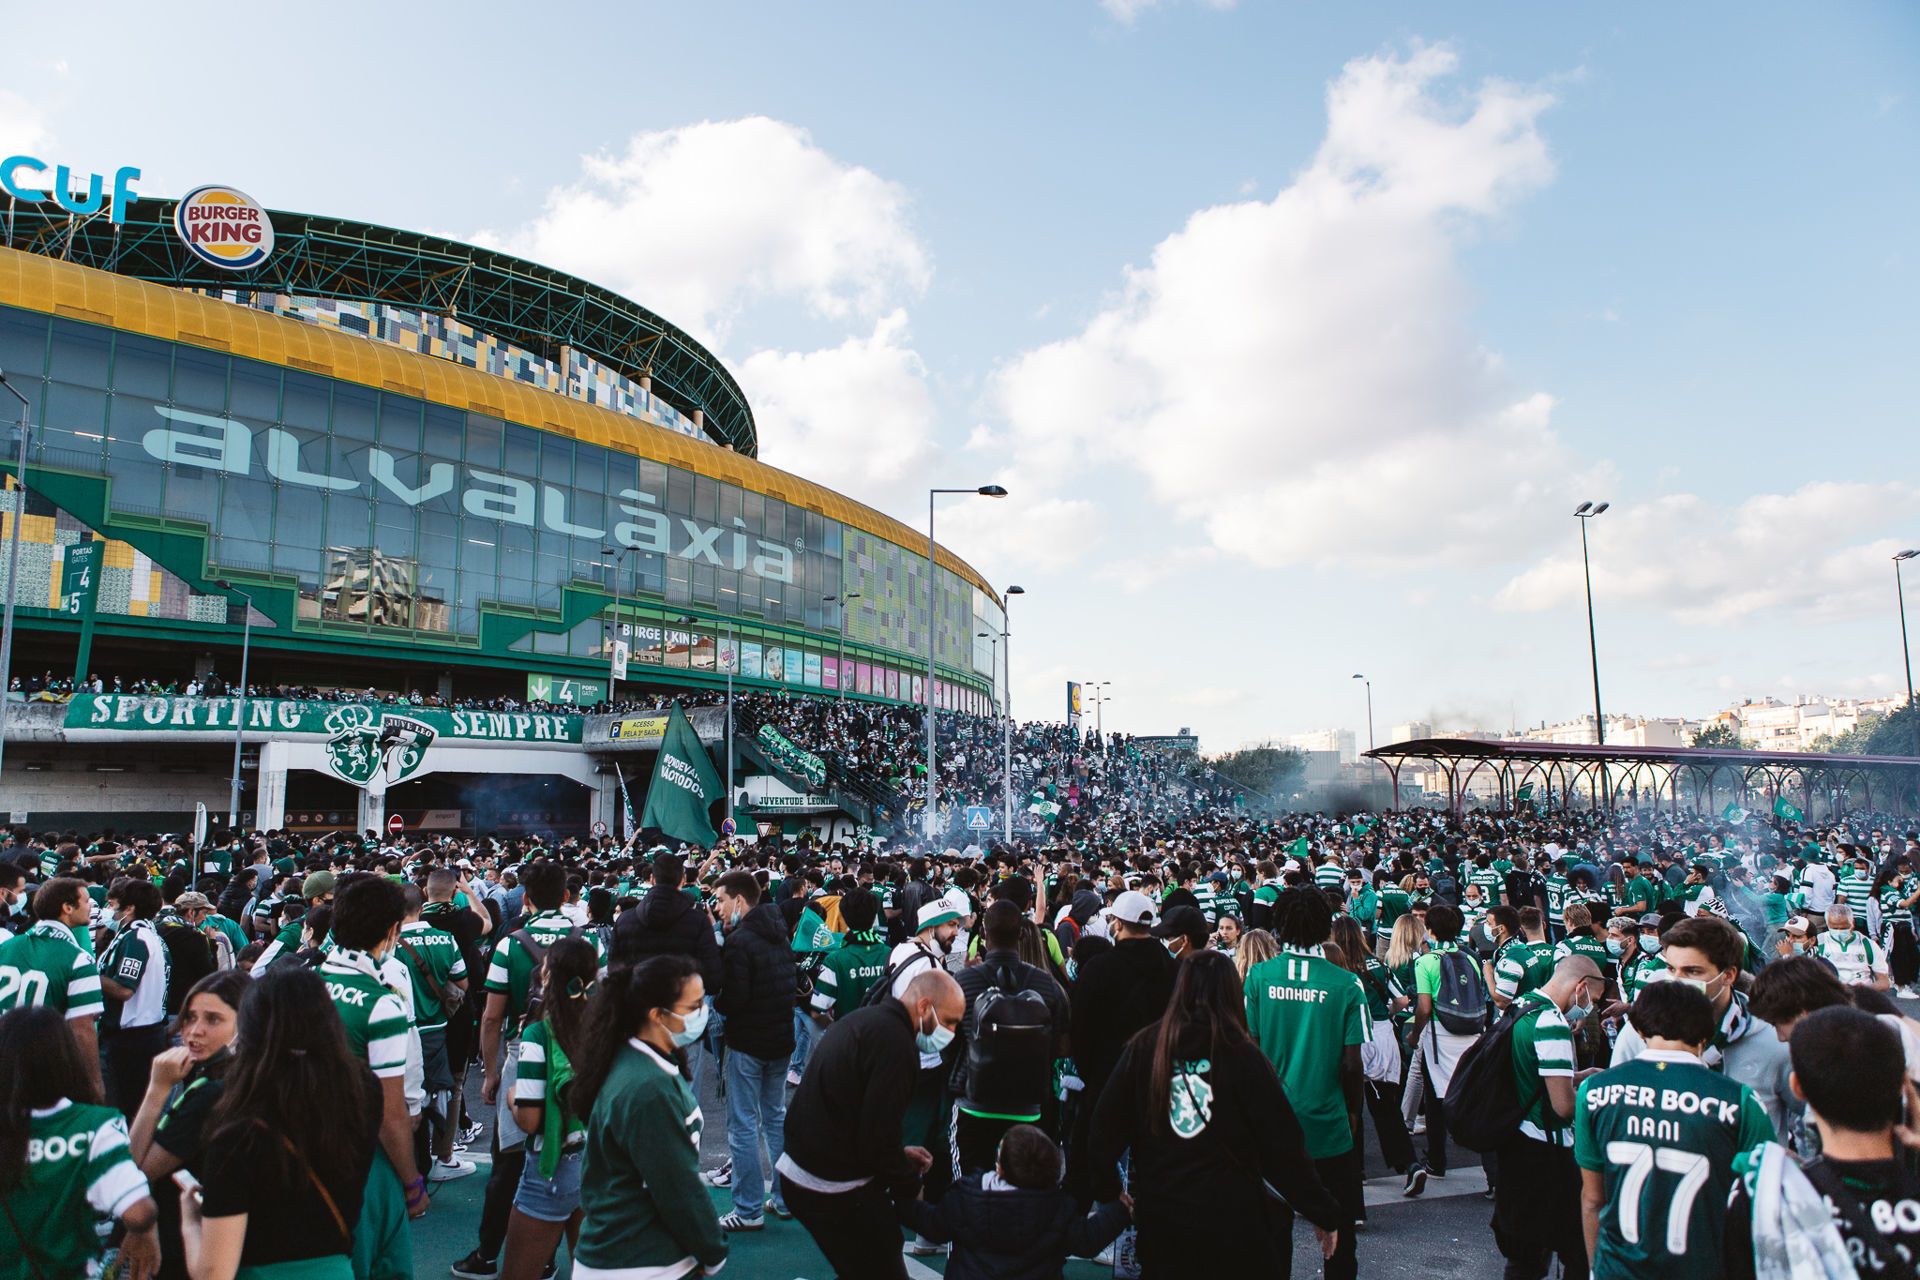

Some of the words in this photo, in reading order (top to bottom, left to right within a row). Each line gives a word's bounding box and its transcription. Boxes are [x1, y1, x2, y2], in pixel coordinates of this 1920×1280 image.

[0, 155, 141, 224] cuf
[188, 206, 259, 222] BURGER
[191, 222, 262, 243] KING
[72, 547, 93, 556] PORTAS
[80, 566, 90, 588] 4
[70, 592, 80, 614] 5
[671, 631, 698, 646] KING
[559, 680, 574, 703] 4
[92, 695, 301, 729] SPORTING
[385, 718, 413, 731] JUVE
[415, 726, 433, 738] LEO
[451, 710, 569, 740] SEMPRE
[612, 726, 620, 737] P
[759, 796, 804, 806] JUVENTUDE
[425, 935, 450, 946] BOCK
[1269, 986, 1328, 1003] BONHOFF
[1586, 1084, 1656, 1111] SUPER
[1661, 1089, 1739, 1125] BOCK
[1627, 1115, 1680, 1142] NANI
[1606, 1141, 1710, 1255] 77
